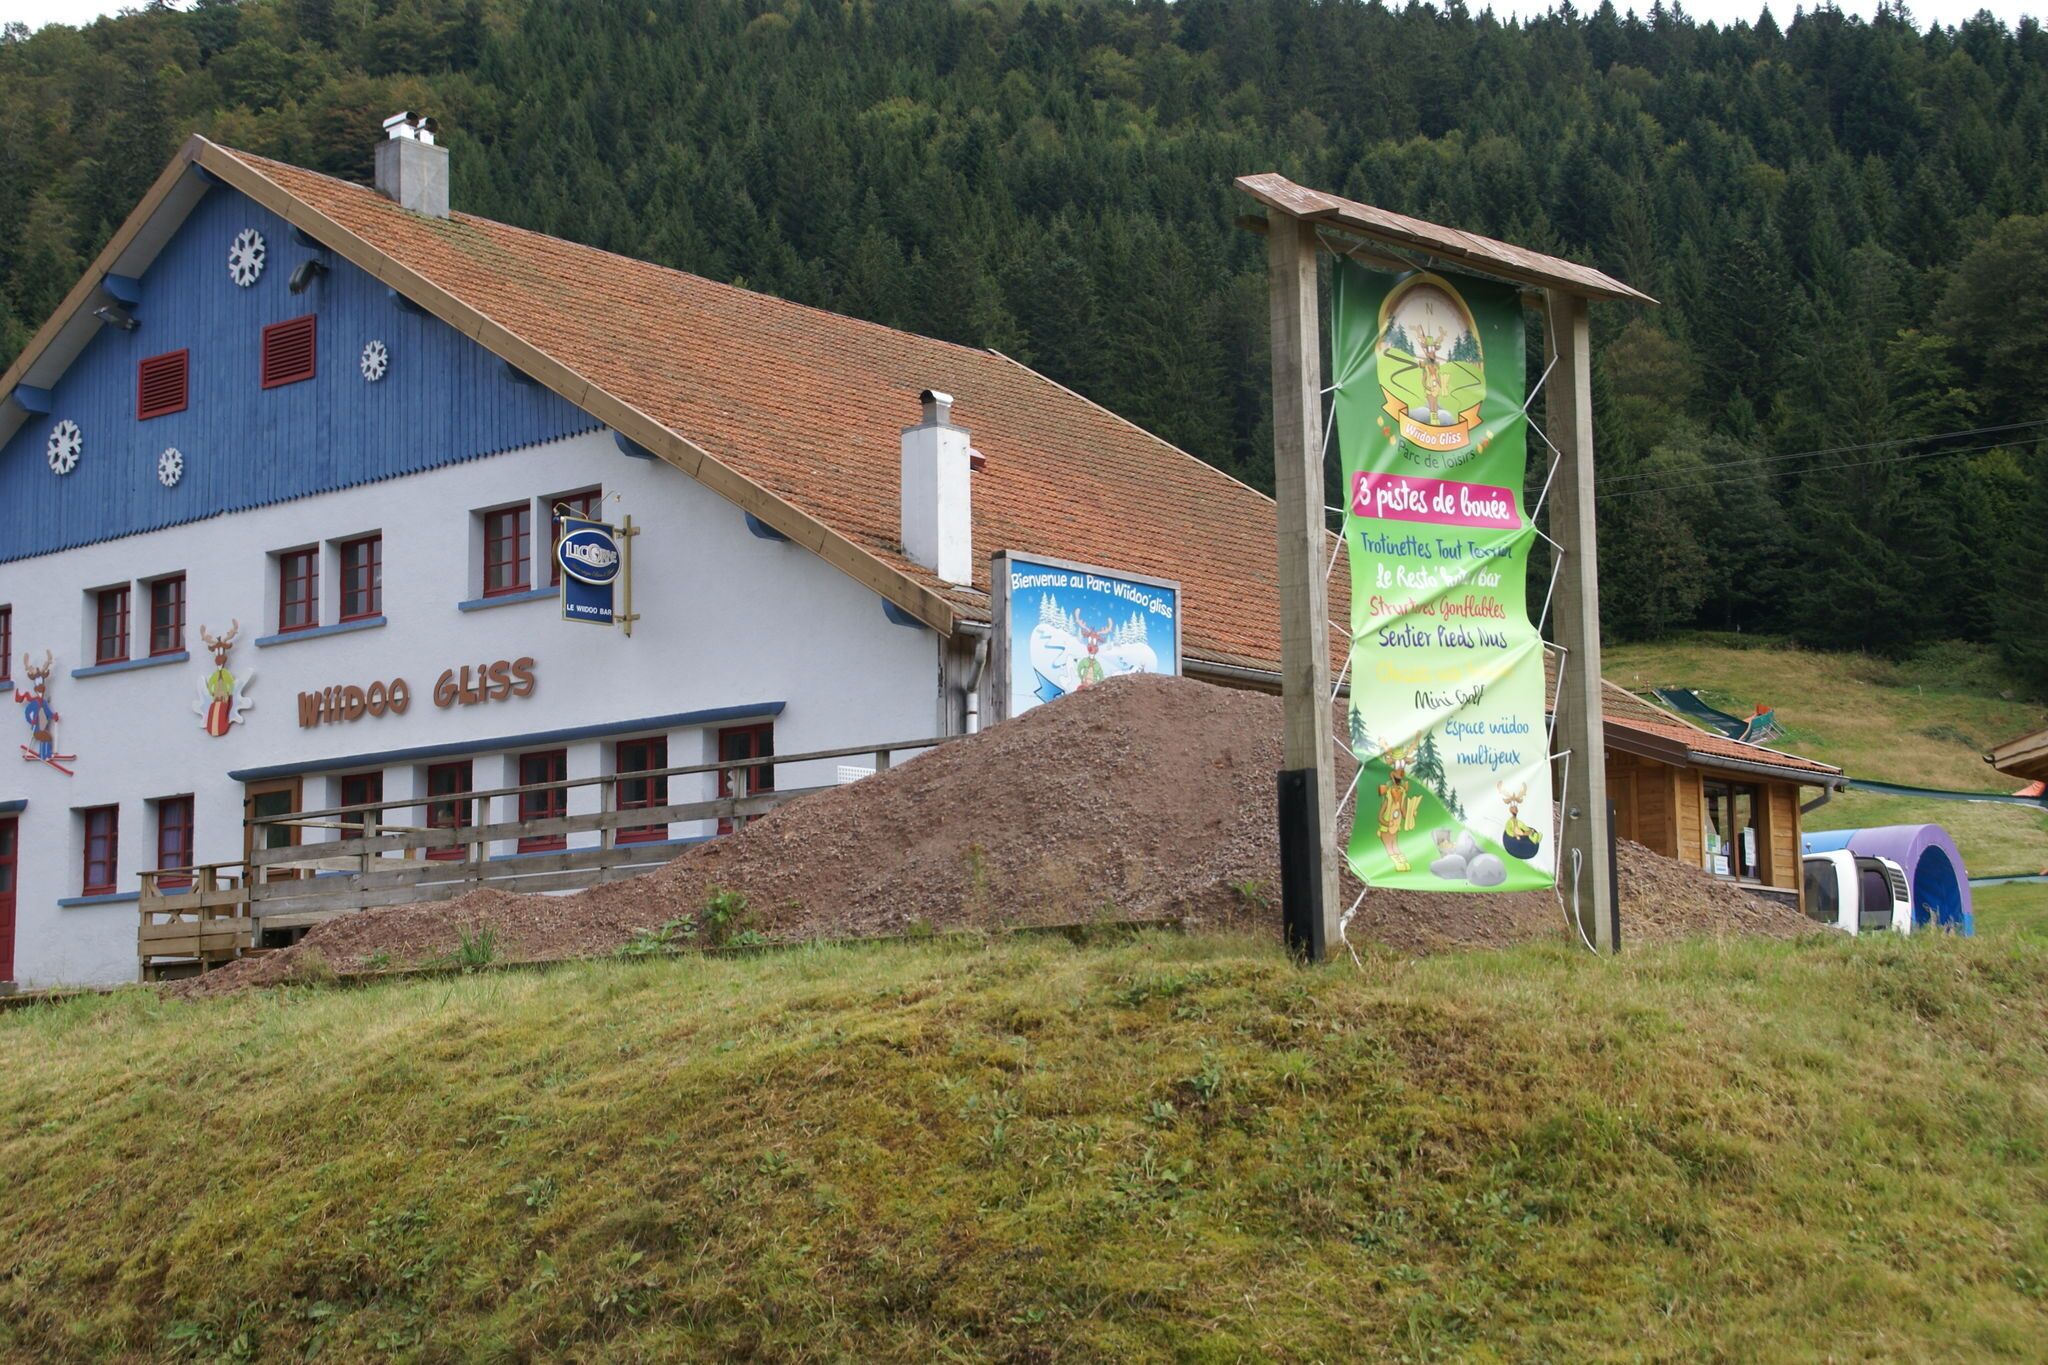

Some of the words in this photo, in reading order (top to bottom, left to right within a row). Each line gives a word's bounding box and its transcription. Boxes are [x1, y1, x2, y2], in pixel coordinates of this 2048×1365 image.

[1398, 440, 1420, 465] Parc
[1424, 453, 1440, 469] de
[1442, 449, 1476, 469] loisirs
[1360, 477, 1371, 506] 3
[1376, 482, 1429, 518] pistes
[1433, 483, 1455, 515] de
[1460, 485, 1510, 520] bouée
[1361, 532, 1431, 559] Trotinettes
[1436, 539, 1462, 560] Tout
[1011, 573, 1066, 590] Bienvenue
[1070, 574, 1084, 589] au
[1086, 575, 1111, 593] Parc
[1376, 563, 1392, 589] Le
[576, 605, 597, 614] WIIDOO
[600, 607, 612, 616] BAR
[1440, 595, 1506, 621] Gonflables
[1378, 623, 1431, 648] Sentier
[1437, 624, 1475, 649] Pieds
[1477, 626, 1507, 649] Nus
[1415, 690, 1453, 709] Mini
[1455, 684, 1485, 710] Golf
[1445, 714, 1484, 740] Espace
[1489, 715, 1529, 734] wiidoo
[1457, 744, 1520, 772] multijeux
